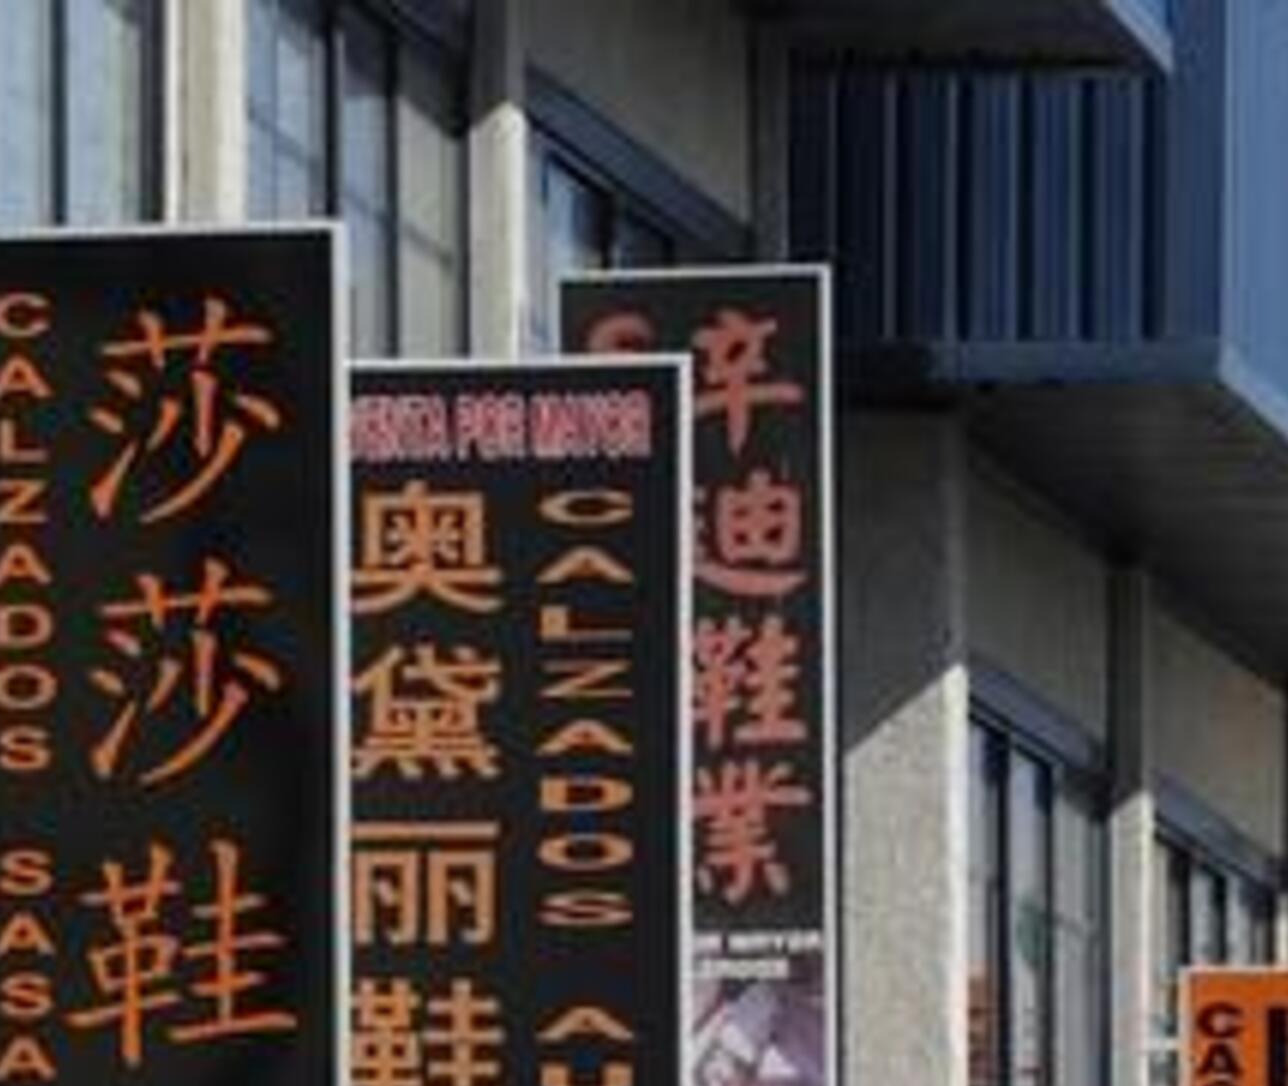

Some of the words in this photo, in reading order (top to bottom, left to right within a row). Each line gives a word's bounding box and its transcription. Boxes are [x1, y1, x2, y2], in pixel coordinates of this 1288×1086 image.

[456, 392, 526, 460] POR
[530, 390, 652, 459] MAYOR
[536, 490, 634, 926] CALZADOS
